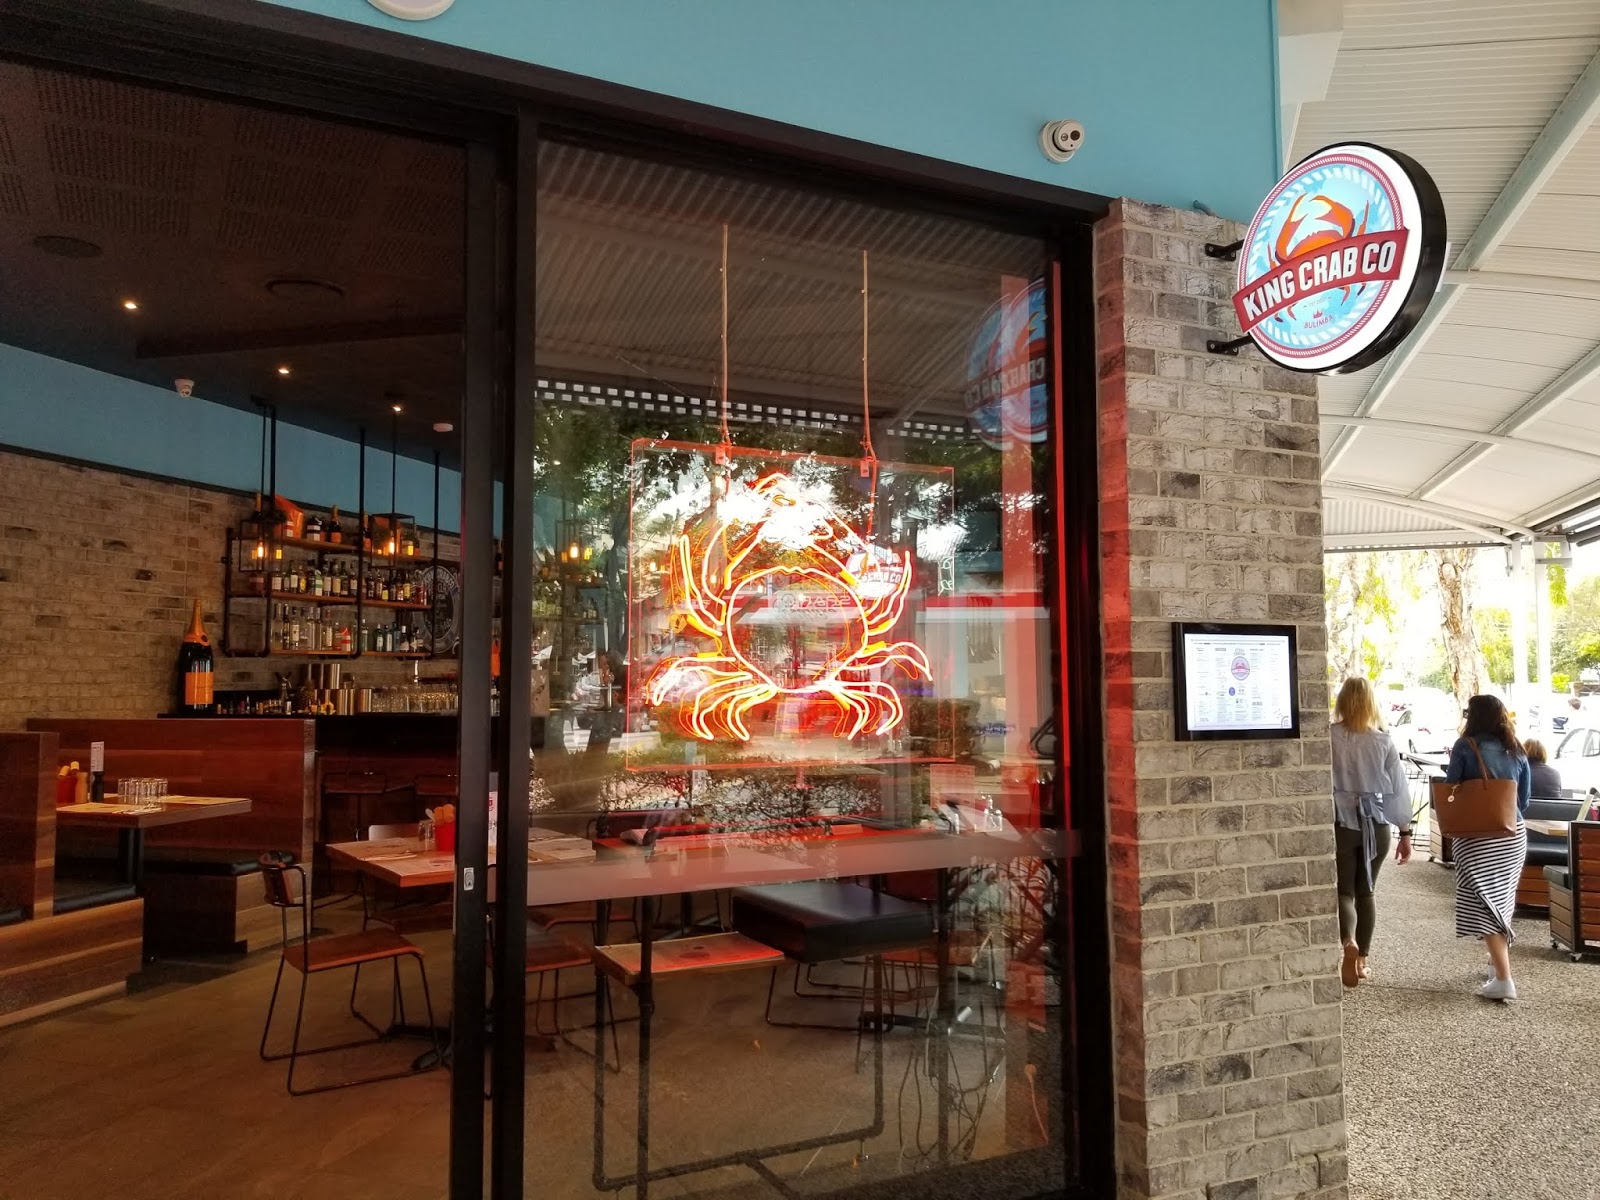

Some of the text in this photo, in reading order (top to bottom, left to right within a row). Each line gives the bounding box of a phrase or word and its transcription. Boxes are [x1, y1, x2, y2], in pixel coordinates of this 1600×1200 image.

[1242, 240, 1397, 322] KING CRAB CO
[1304, 315, 1333, 329] BULIMBA
[890, 573, 902, 583] CO
